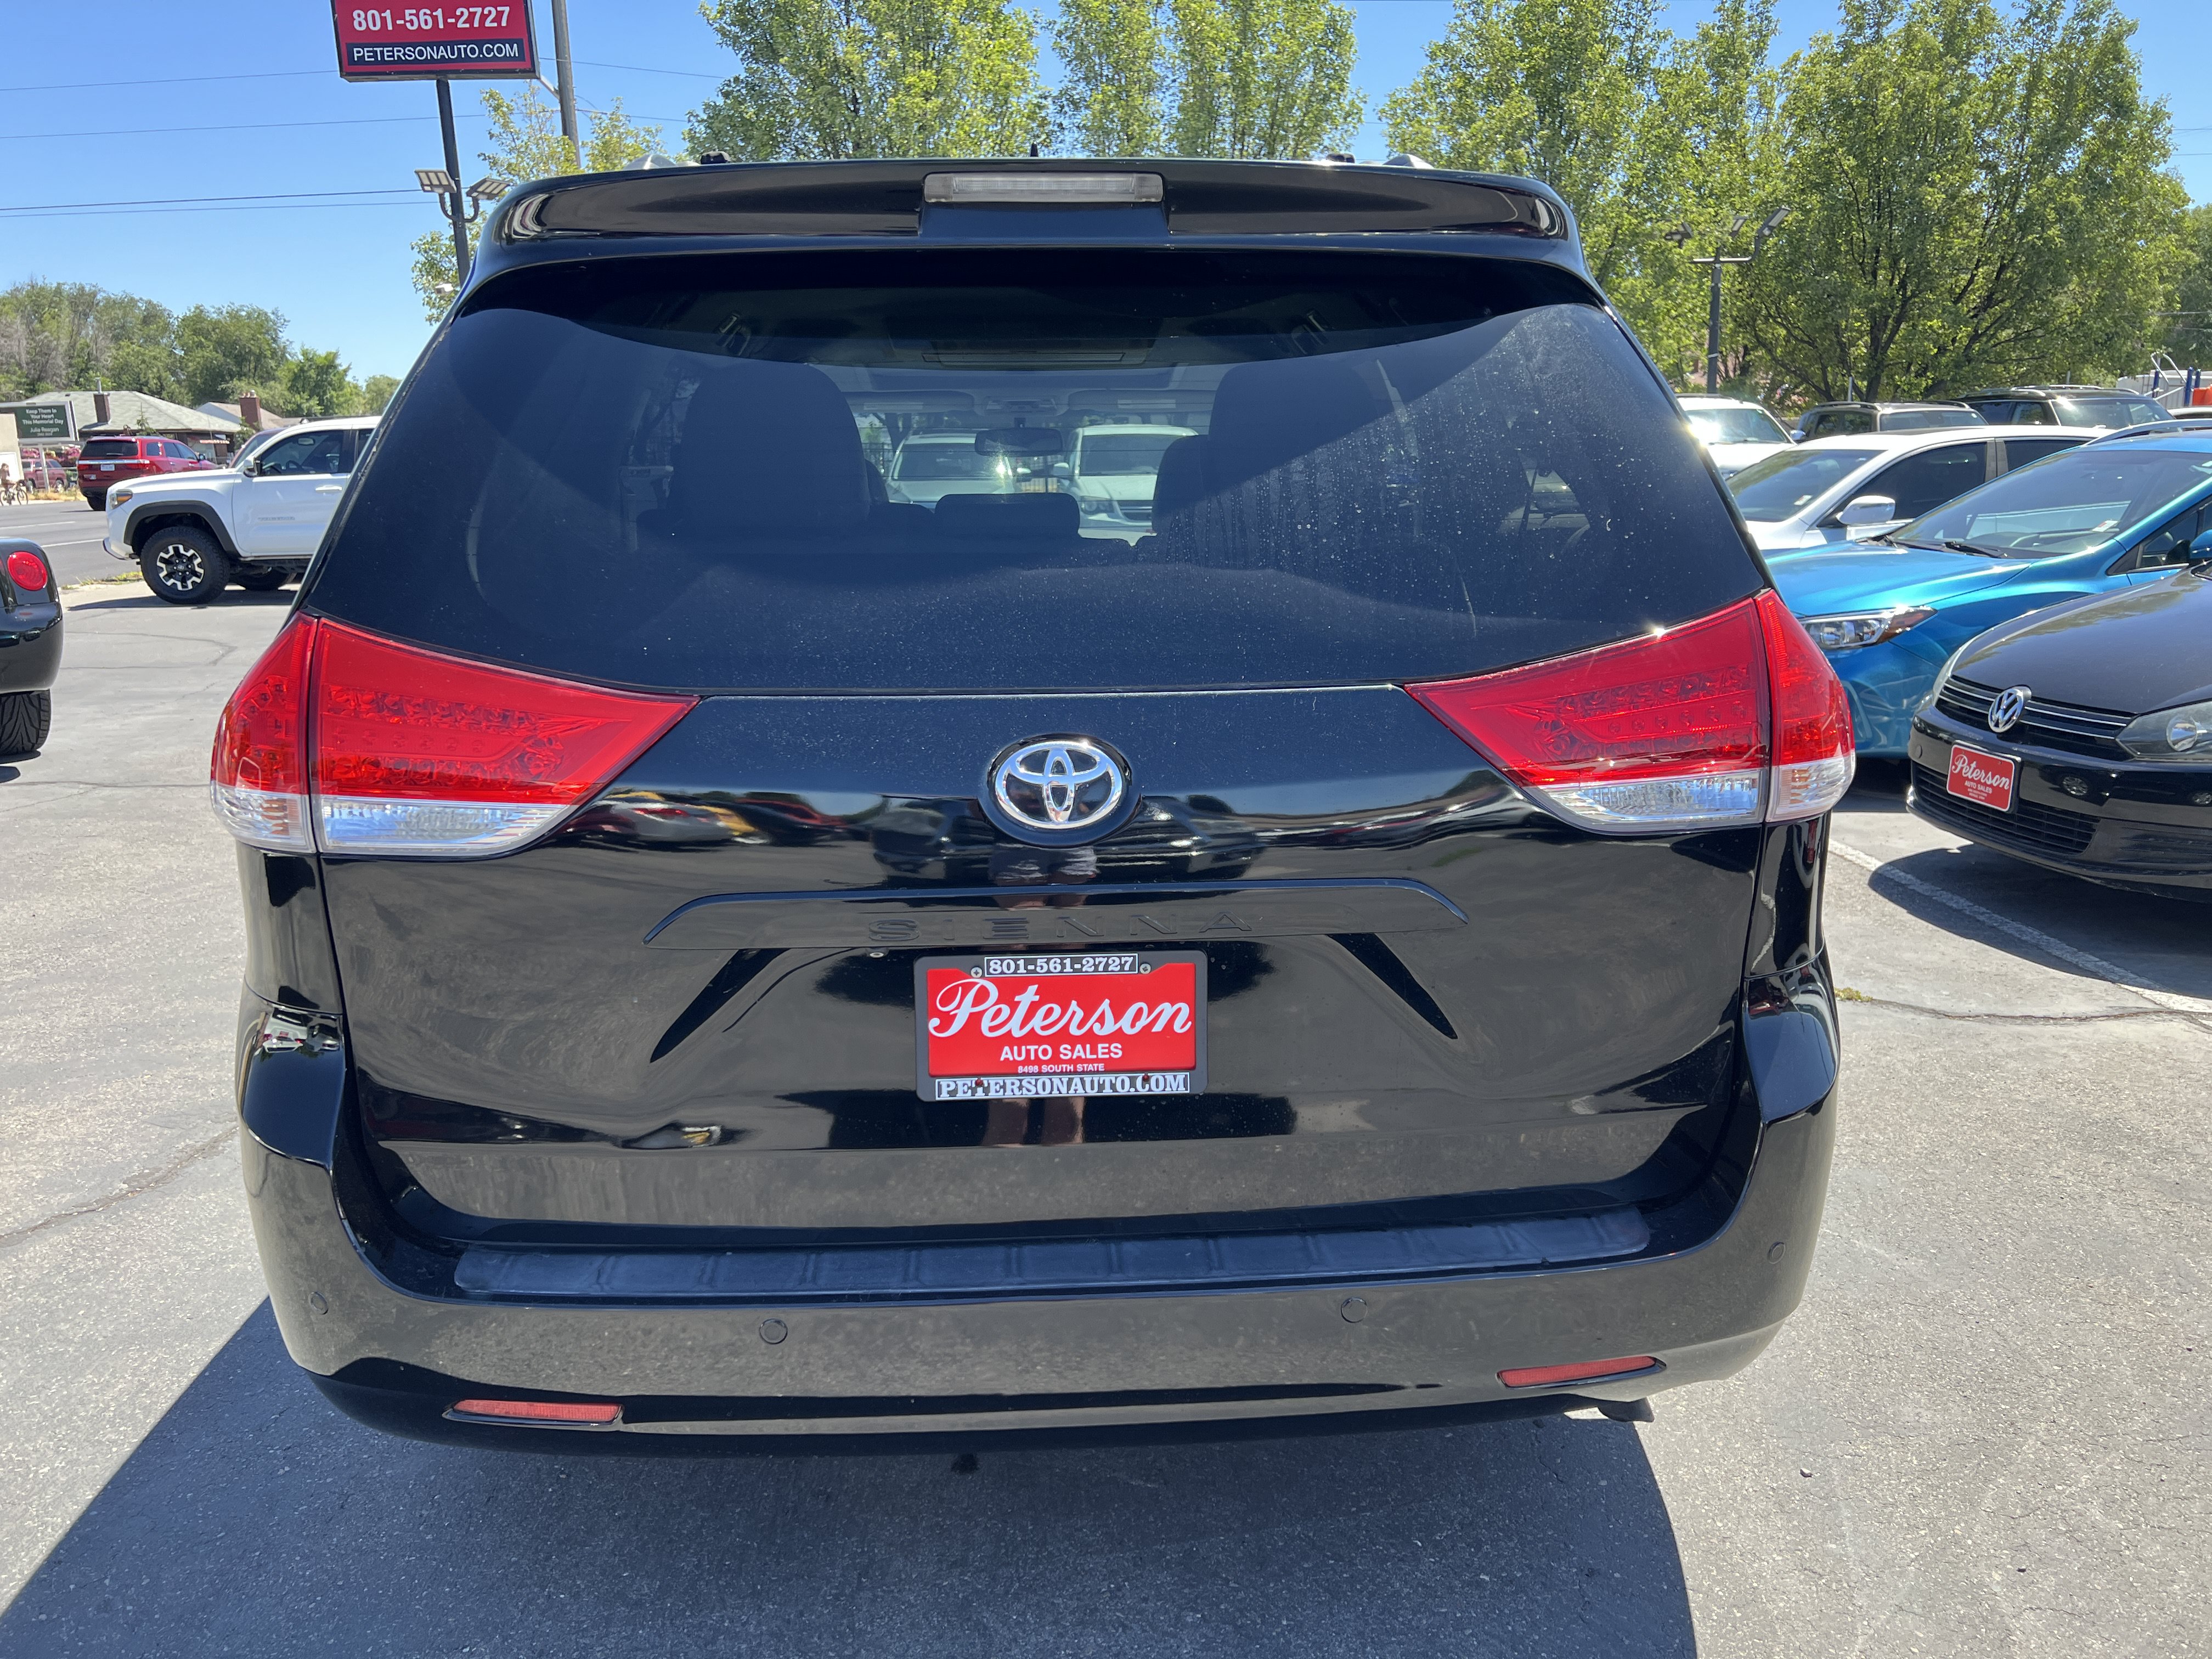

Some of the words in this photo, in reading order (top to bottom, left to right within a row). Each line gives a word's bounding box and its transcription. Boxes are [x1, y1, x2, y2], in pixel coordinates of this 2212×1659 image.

[352, 6, 510, 31] 801-561-2727
[353, 43, 519, 61] PETERSONAUTO.COM
[1951, 754, 2010, 790] Peterson
[1965, 780, 1977, 789] AUTO
[1977, 784, 1993, 794] SALES
[868, 911, 1252, 941] SIENNA
[989, 956, 1134, 974] 801-561-2727
[928, 978, 1192, 1037] Peterson
[1000, 1044, 1053, 1061] AUTO
[1059, 1043, 1122, 1059] SALES
[1041, 1064, 1074, 1073] SOUTH
[1076, 1063, 1105, 1071] STATE
[940, 1074, 1186, 1098] PETERSONAUTO.COM
